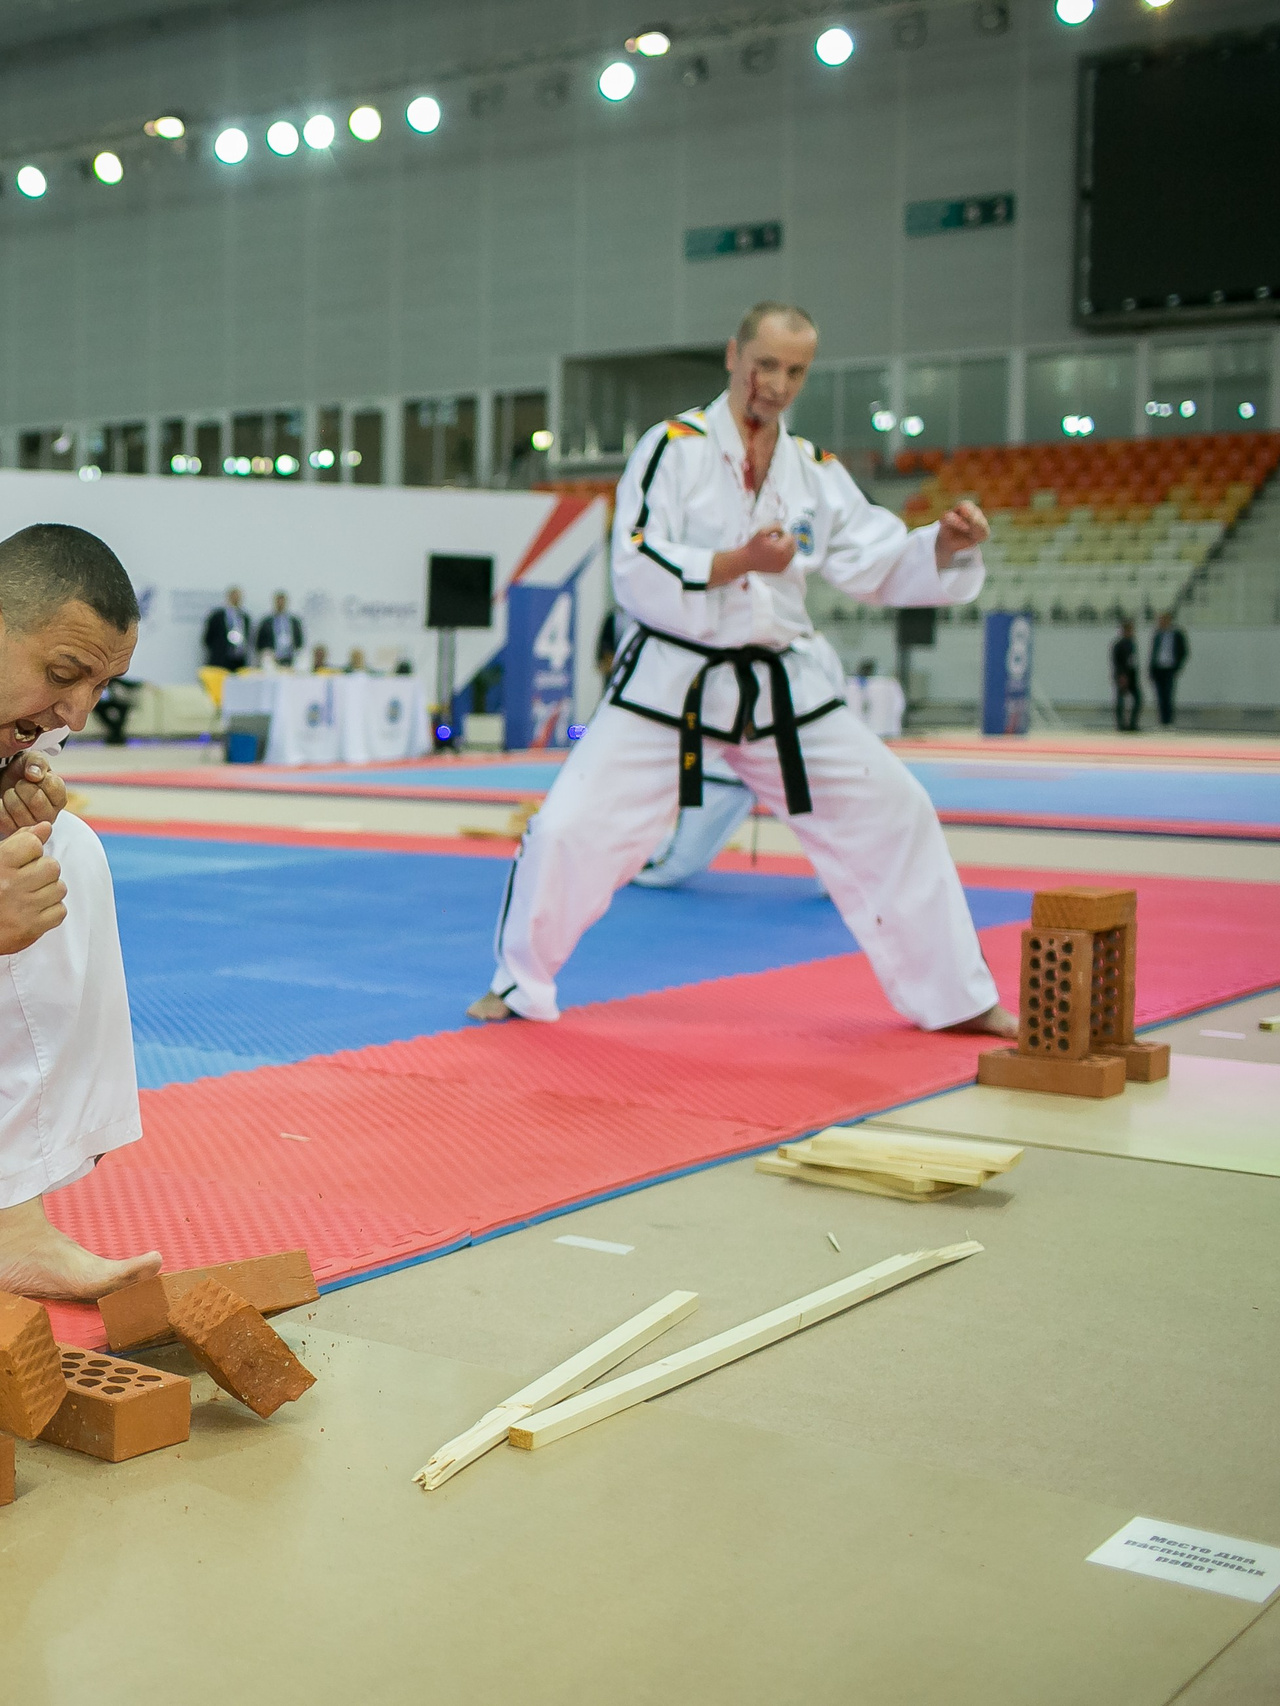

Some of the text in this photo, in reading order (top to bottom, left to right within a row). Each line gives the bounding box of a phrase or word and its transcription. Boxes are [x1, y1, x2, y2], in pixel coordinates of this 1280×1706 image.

[532, 591, 572, 673] 4
[1149, 1535, 1256, 1565] Место для
